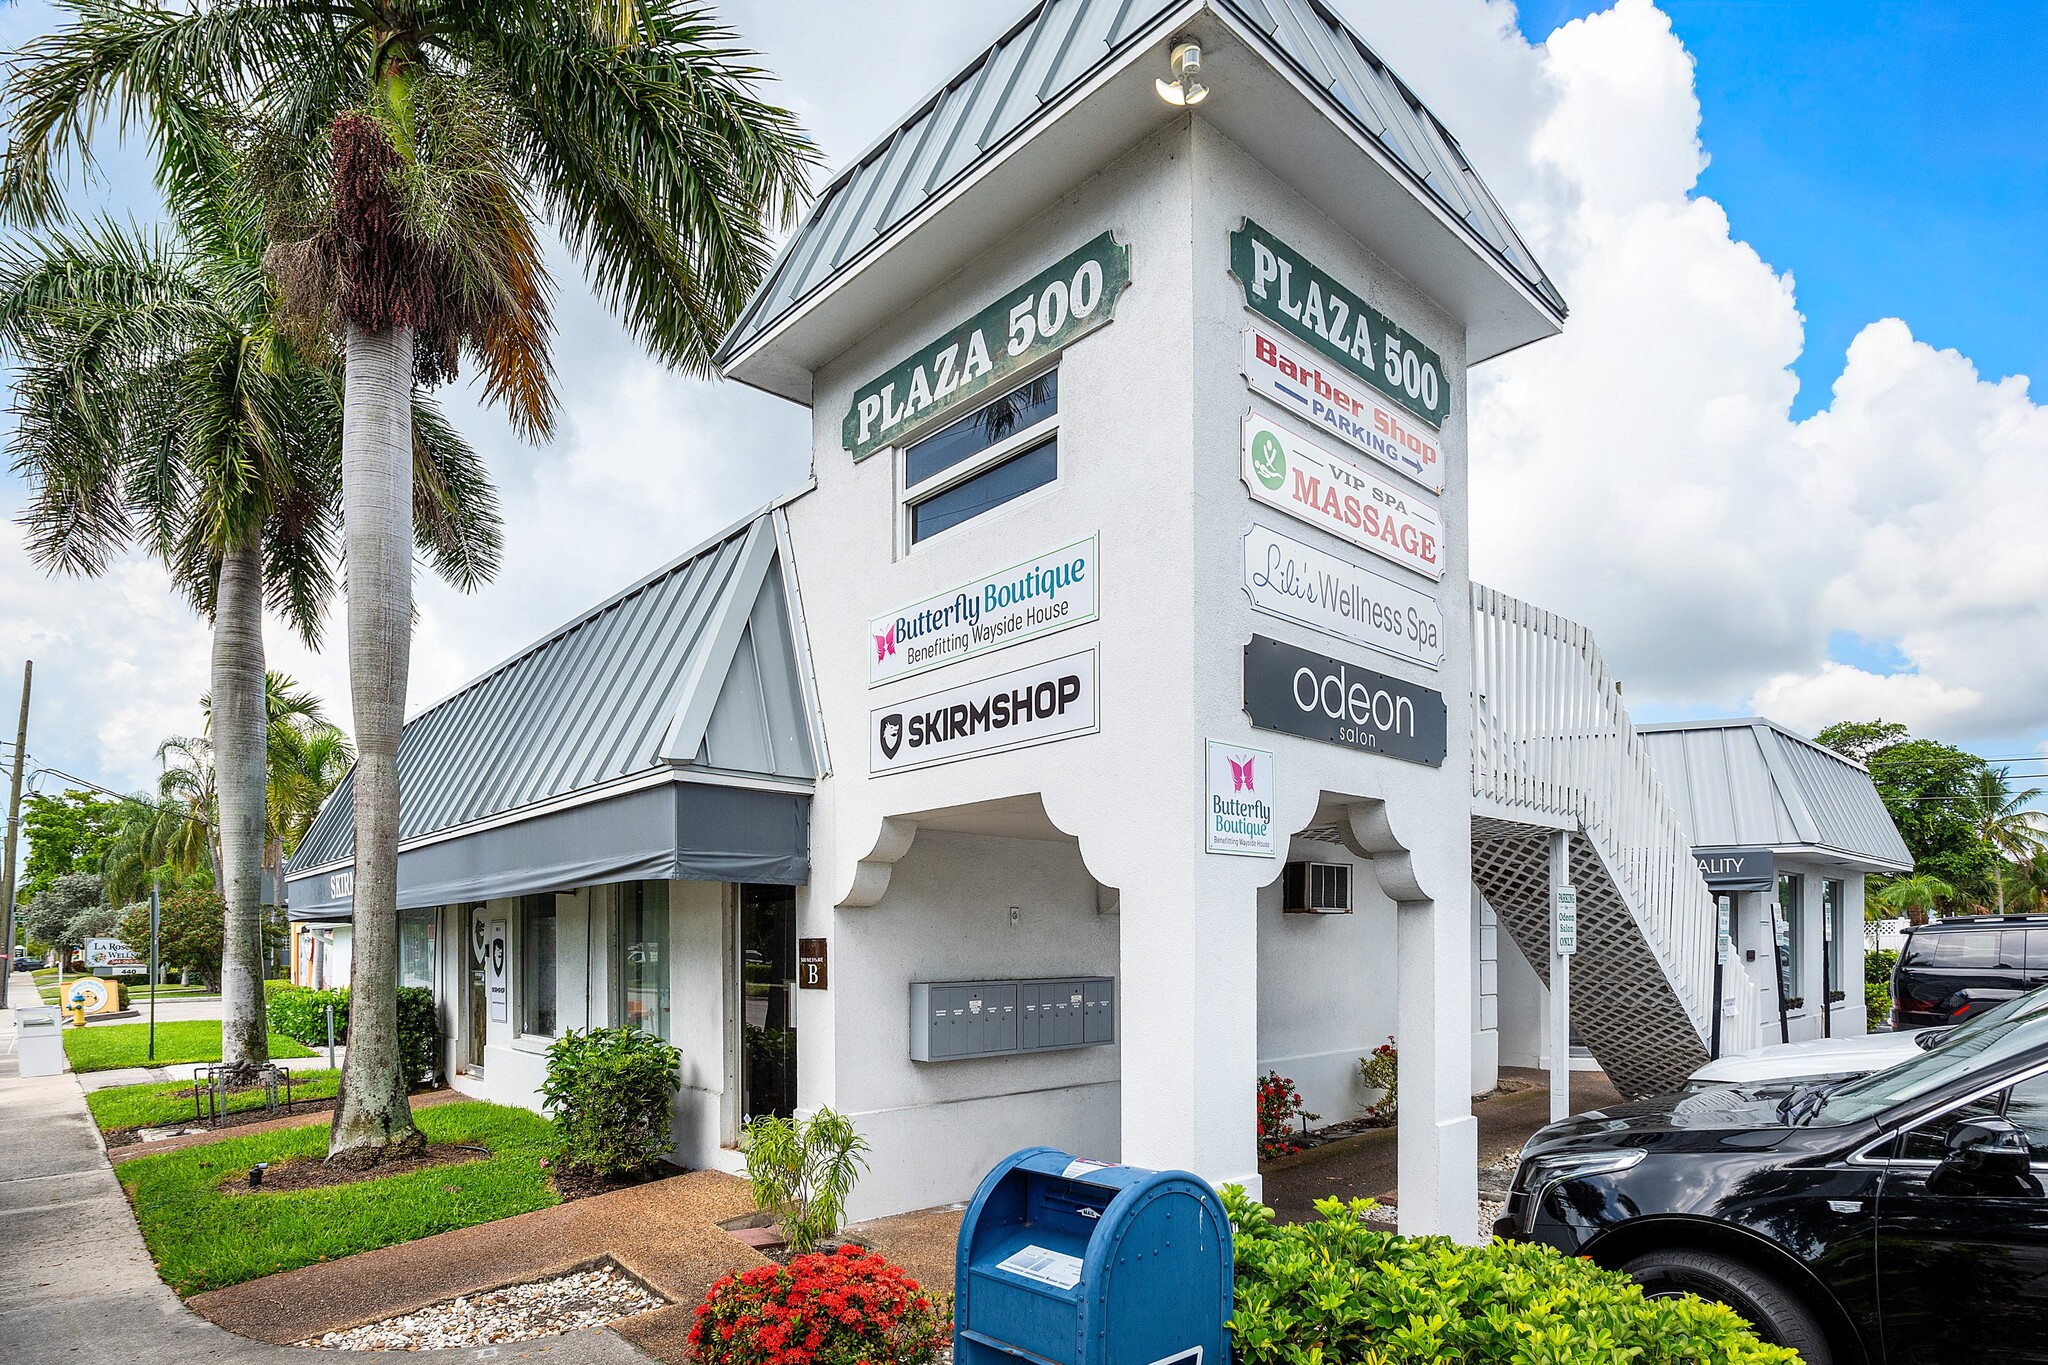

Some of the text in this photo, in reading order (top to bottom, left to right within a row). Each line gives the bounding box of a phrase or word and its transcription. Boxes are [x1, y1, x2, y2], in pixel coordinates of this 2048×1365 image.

[1251, 238, 1439, 411] PLAZA 500
[857, 259, 1104, 446] PLAZA 500
[1255, 333, 1437, 465] Barber Shop
[1312, 399, 1399, 461] PARKING
[1329, 463, 1409, 515] VIP SPA
[1292, 467, 1437, 564] MASSAGE
[895, 558, 1086, 644] Butterfly Boutique
[1252, 543, 1438, 652] Lili's Wellness Spa
[907, 600, 1069, 665] Benefitting Wayside House
[908, 674, 1081, 749] SKIRMSHOP
[1293, 665, 1415, 738] odeon
[1339, 726, 1377, 748] salon
[1213, 794, 1271, 825] Butterfly
[1215, 815, 1267, 839] Boutique
[1239, 838, 1257, 847] Wayside
[1257, 840, 1270, 848] House
[330, 871, 355, 900] SKIRM
[1698, 857, 1745, 874] ALITY
[1558, 912, 1575, 922] Odeon
[1560, 924, 1574, 933] Salon
[109, 943, 131, 951] ROS
[1560, 937, 1575, 947] ONLY
[807, 963, 819, 984] B
